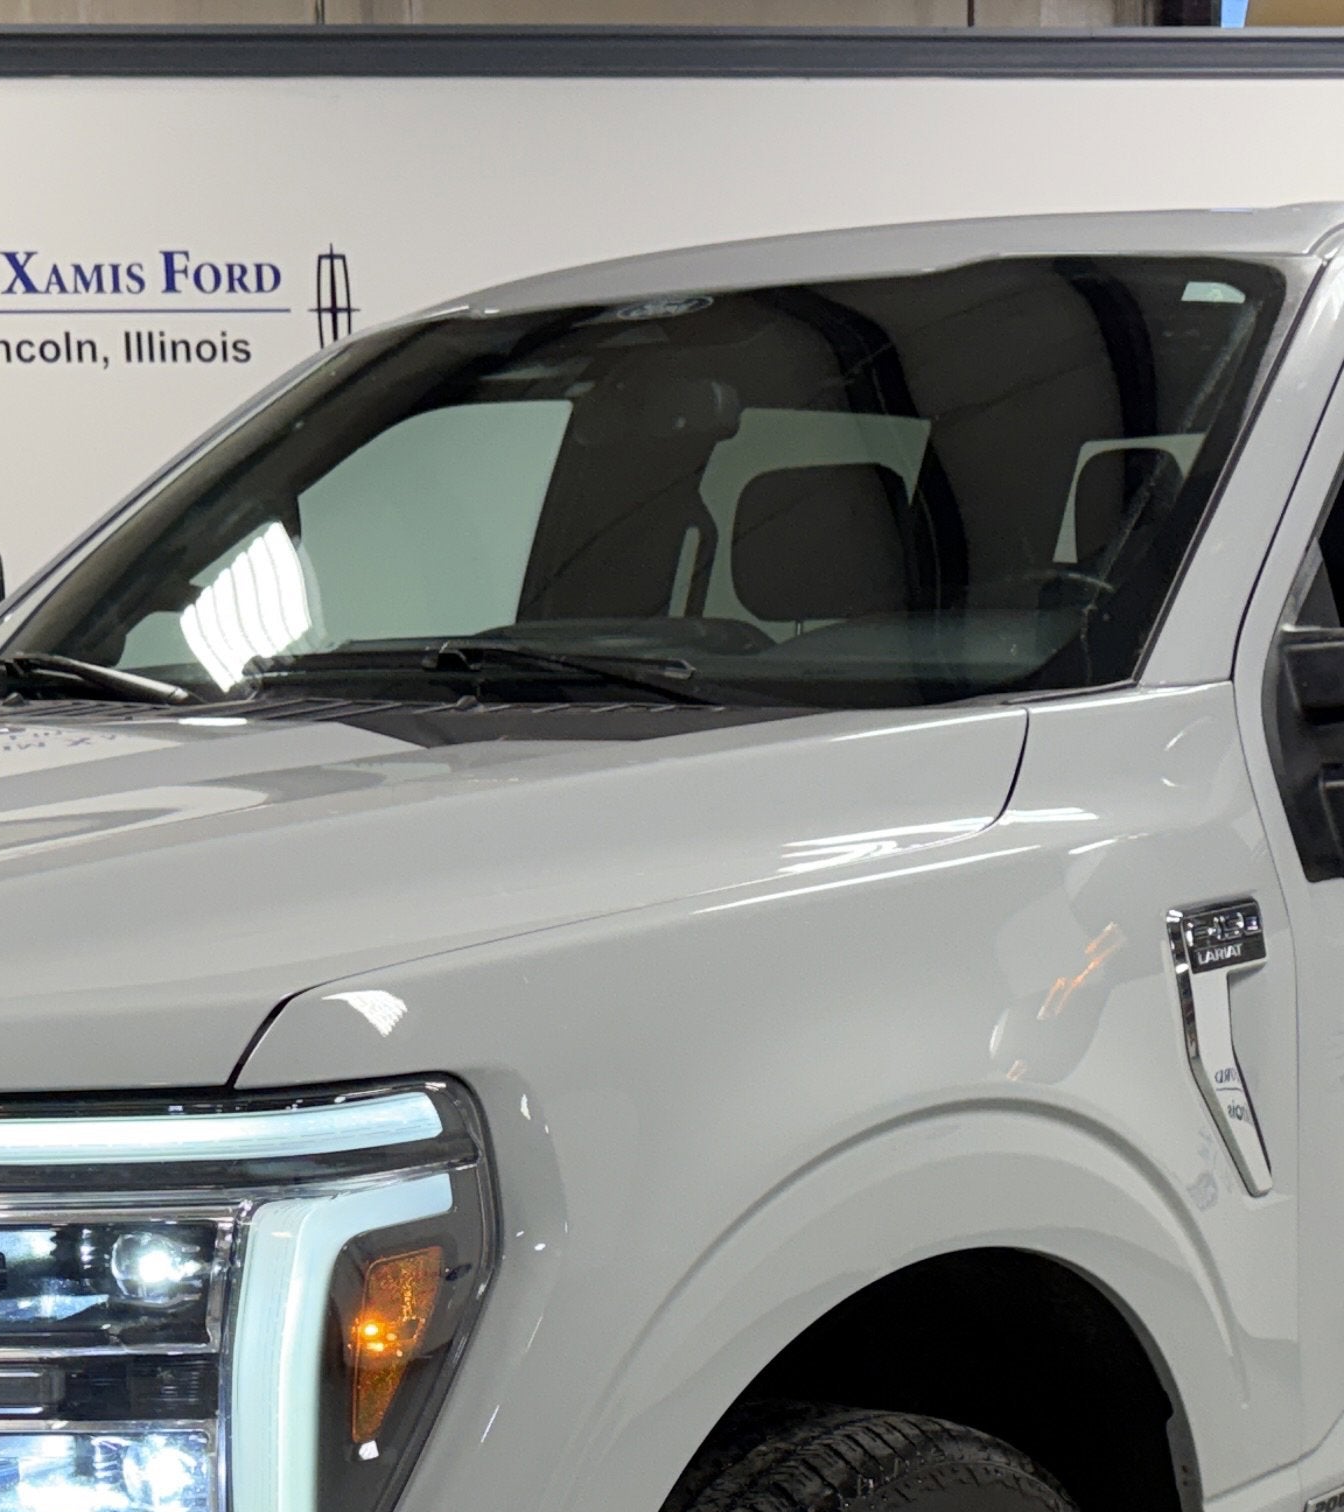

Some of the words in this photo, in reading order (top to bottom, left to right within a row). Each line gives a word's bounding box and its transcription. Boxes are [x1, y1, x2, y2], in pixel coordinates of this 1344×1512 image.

[0, 249, 146, 296] XAMIS
[159, 249, 283, 295] FORD
[123, 331, 252, 364] Illinois
[1197, 943, 1244, 965] LARIAT
